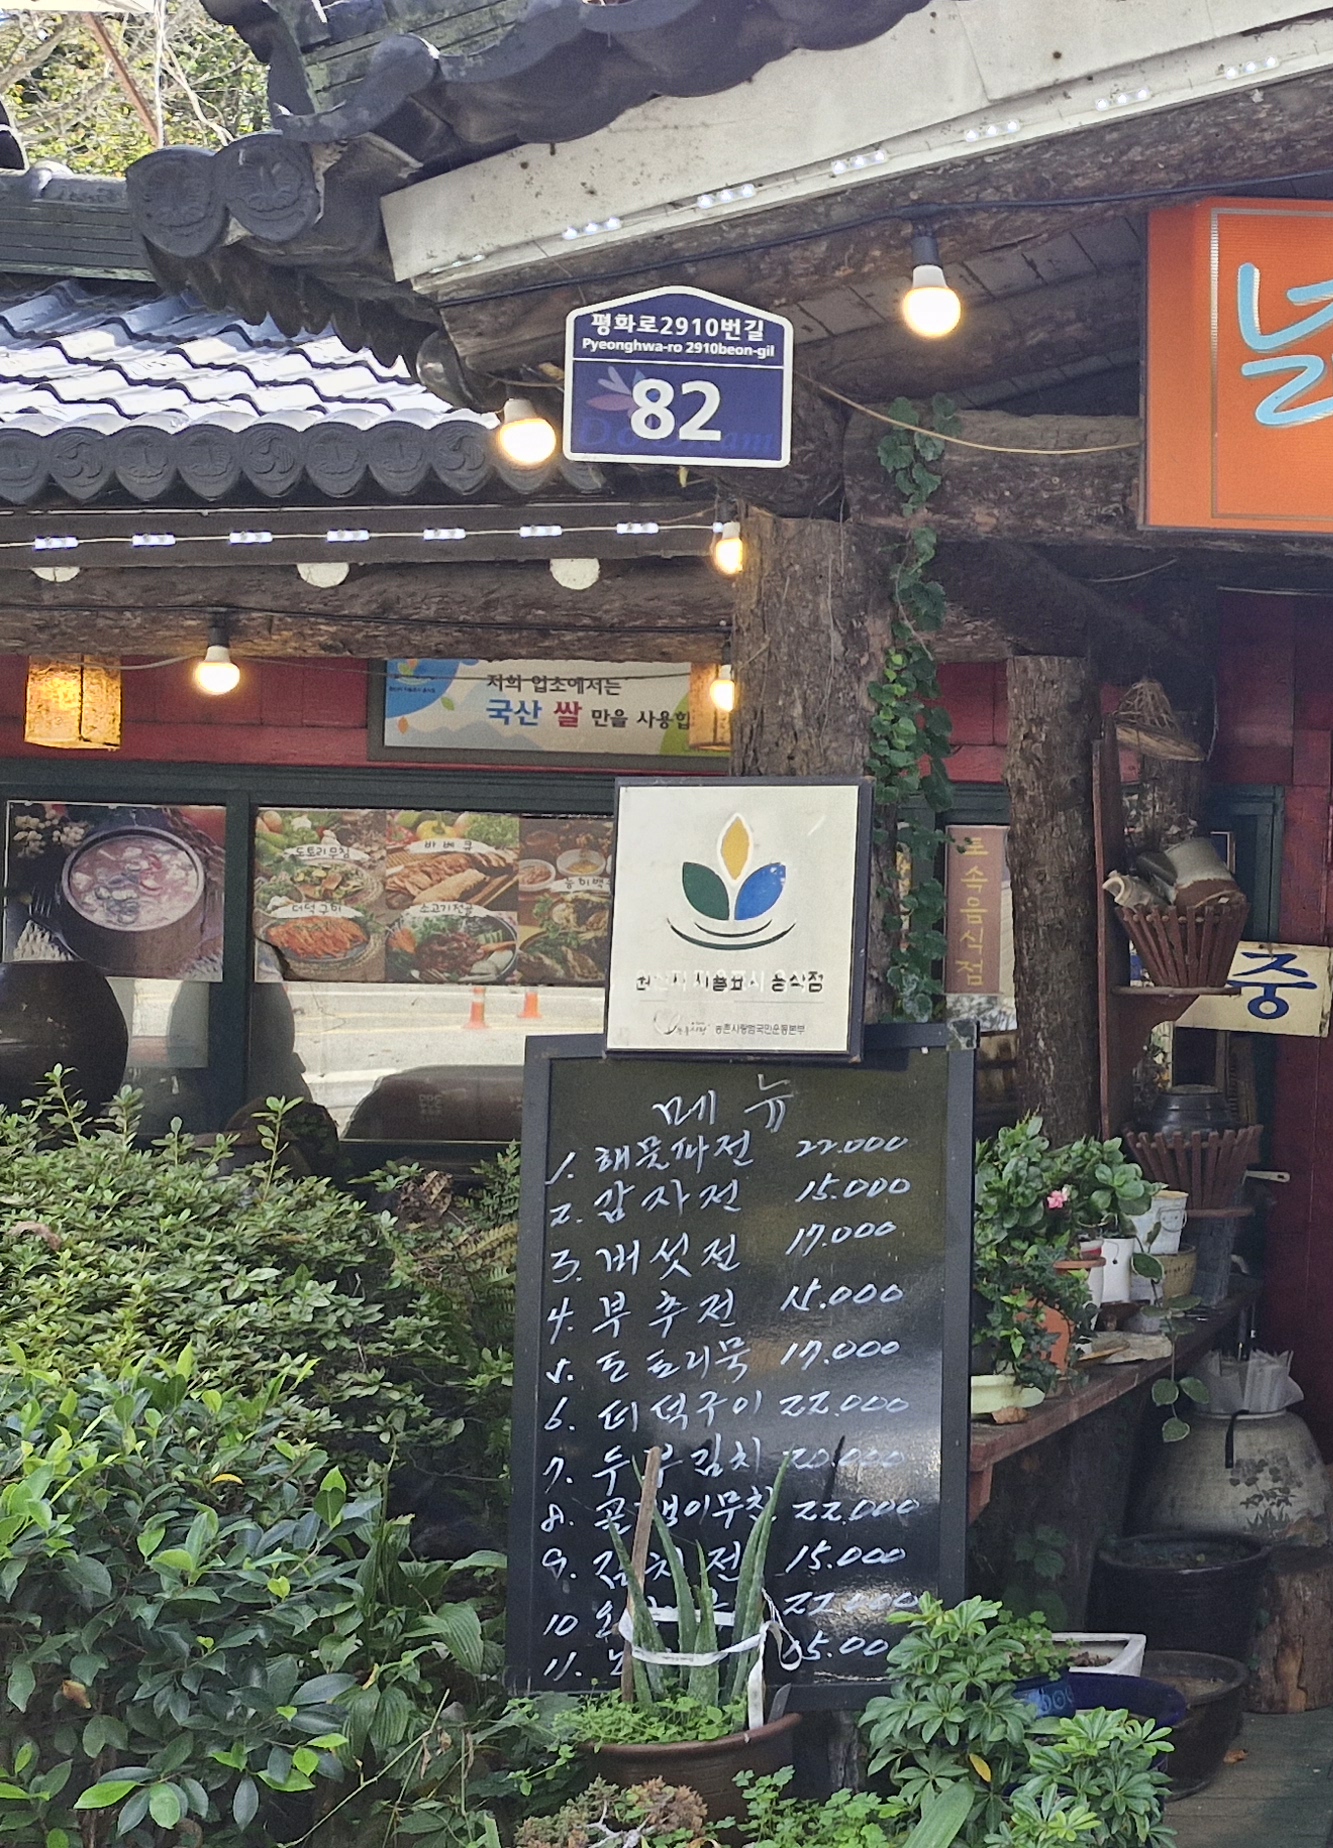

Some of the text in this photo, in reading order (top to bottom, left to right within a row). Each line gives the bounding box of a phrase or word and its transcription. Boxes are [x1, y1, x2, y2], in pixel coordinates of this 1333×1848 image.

[591, 313, 765, 342] 평화로2910번길
[582, 338, 775, 359] Pyeonghwa-ro 2910beon-gil
[630, 378, 722, 441] 82
[487, 674, 522, 693] 저희
[486, 698, 541, 727] 국산
[553, 700, 582, 728] 쌀
[591, 708, 628, 728] 만을
[1226, 952, 1318, 1020] 중
